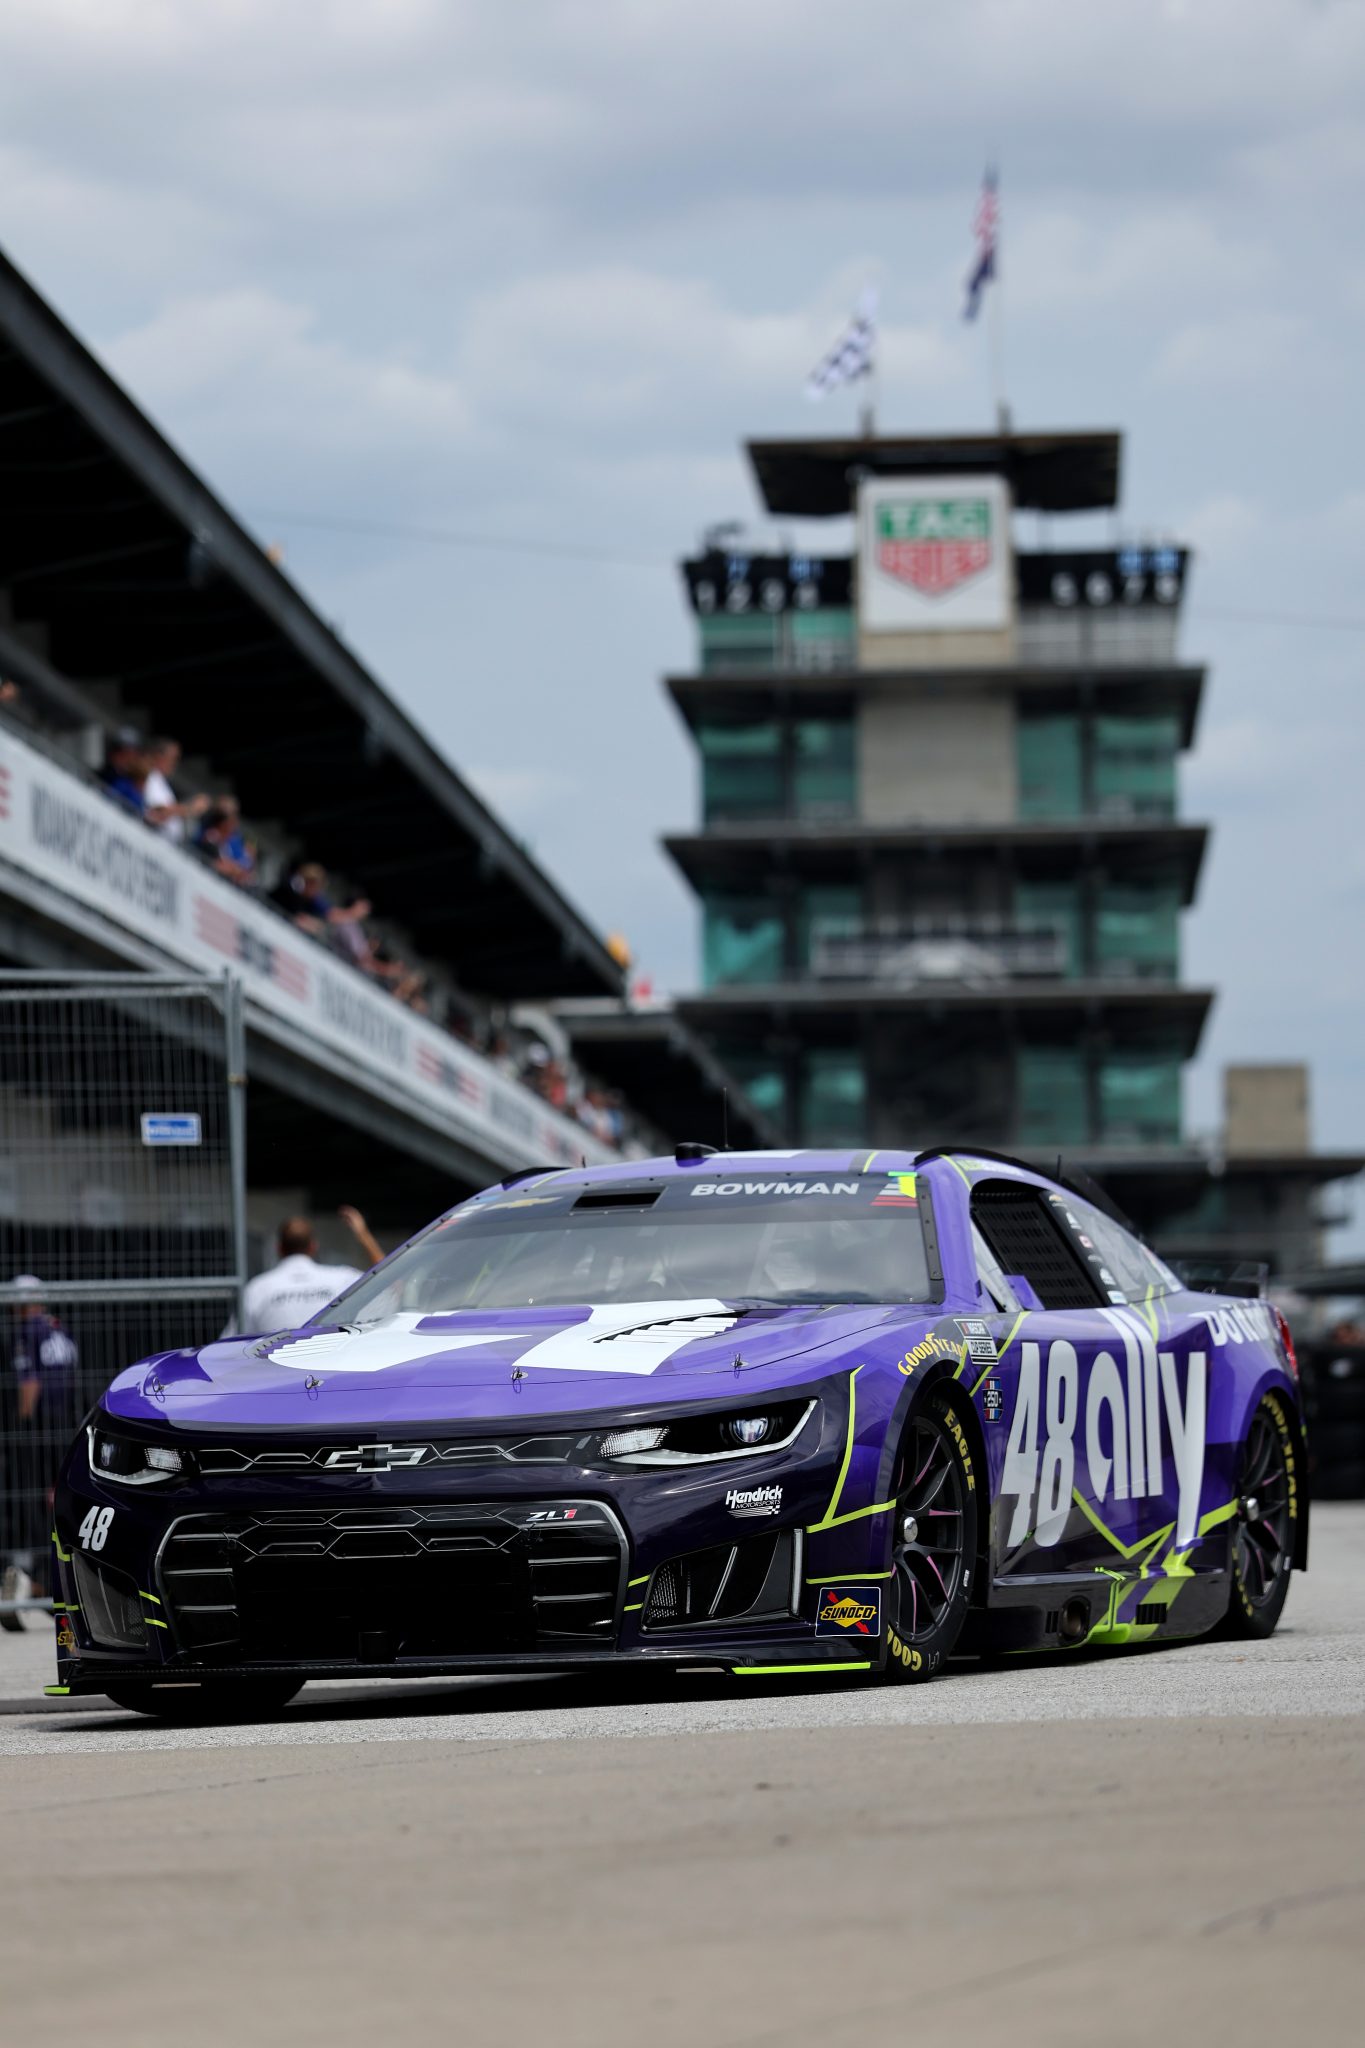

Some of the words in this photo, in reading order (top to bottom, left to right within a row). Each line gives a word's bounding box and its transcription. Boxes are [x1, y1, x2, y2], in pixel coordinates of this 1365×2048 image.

[690, 1182, 859, 1196] BOWMAN
[898, 1333, 964, 1375] GOODYEAR
[987, 1391, 999, 1408] 250
[1085, 1307, 1206, 1548] ally
[944, 1408, 976, 1491] EAGLE
[1000, 1340, 1079, 1548] 48
[725, 1485, 783, 1509] Hendrick
[736, 1500, 781, 1509] MOTORSPORTS
[525, 1509, 578, 1522] ZL1
[78, 1506, 115, 1551] 48
[822, 1606, 876, 1619] SUNOCO
